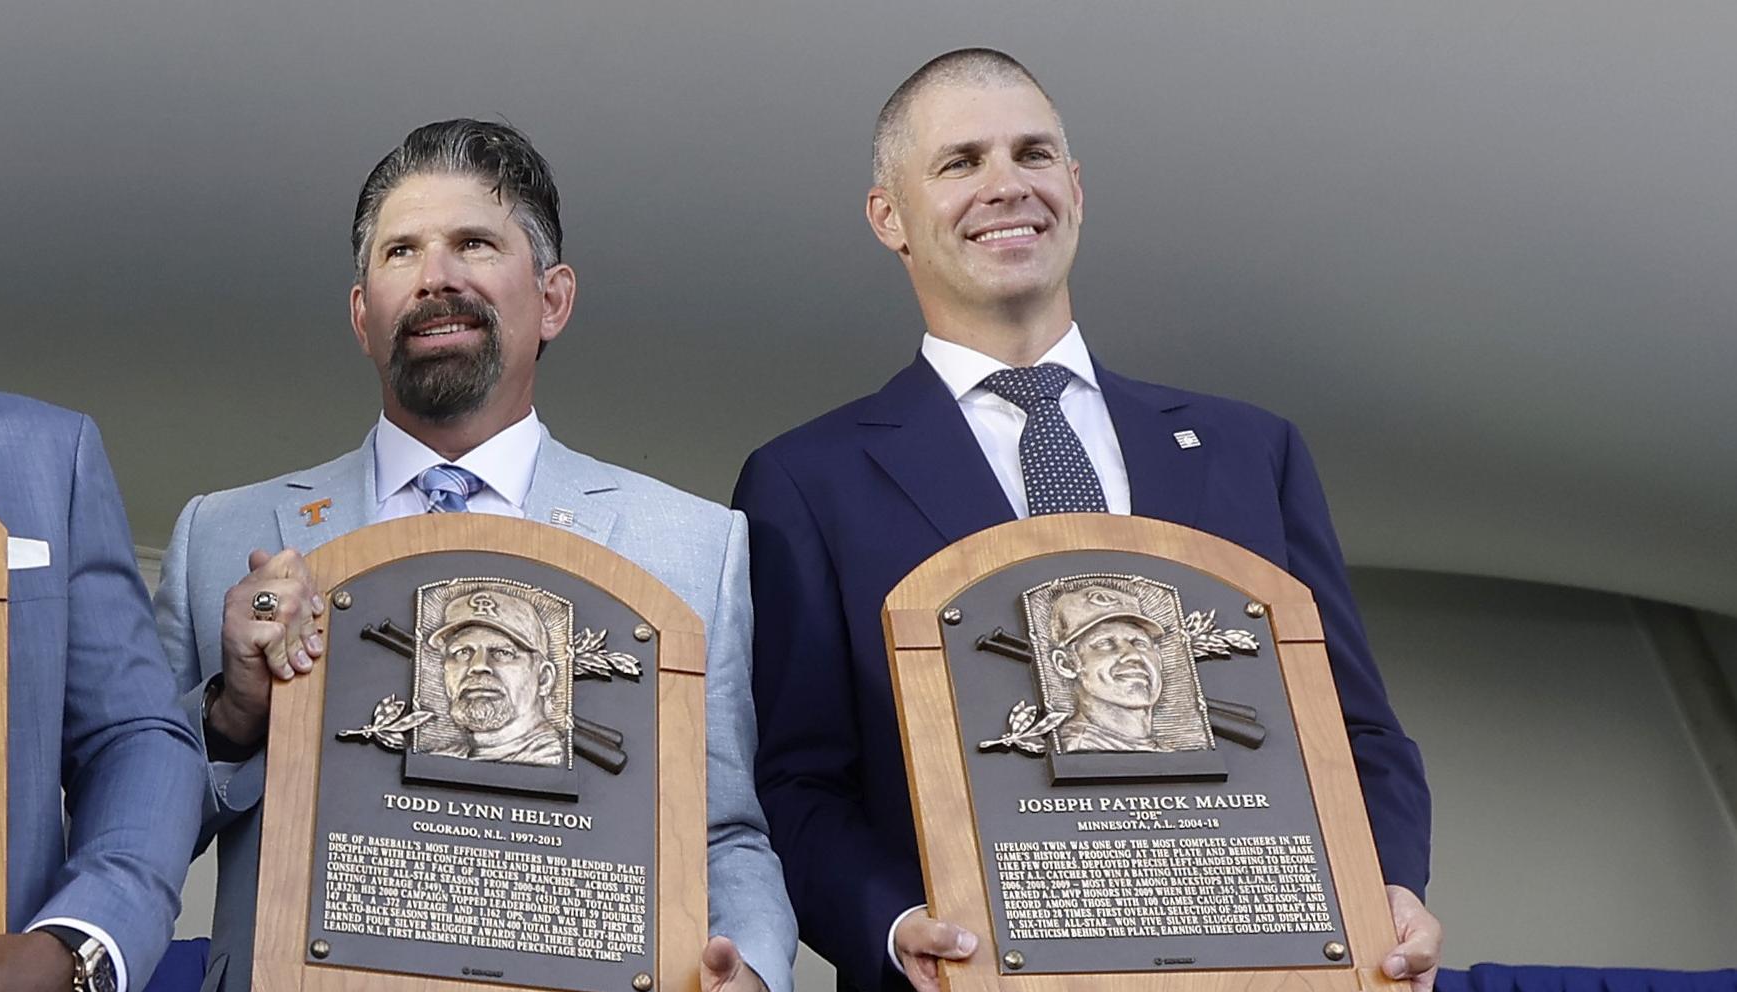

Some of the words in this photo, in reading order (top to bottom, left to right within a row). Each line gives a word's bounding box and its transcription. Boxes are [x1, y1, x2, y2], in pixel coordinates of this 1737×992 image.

[300, 498, 332, 527] T
[384, 794, 440, 811] TODD
[448, 801, 503, 819] LYNN
[511, 808, 591, 828] HELTON
[1019, 798, 1092, 811] JOSEPH
[1099, 796, 1189, 810] PATRICK
[1195, 794, 1269, 807] MAUER
[1077, 818, 1150, 830] MINNESOTA,
[1152, 818, 1175, 828] A.L.
[1177, 818, 1219, 827] 2004-18
[1129, 810, 1161, 819] "JOE"
[413, 821, 480, 837] COLORADO,
[484, 829, 506, 839] N.L.
[510, 832, 561, 845] 1997-2013
[1010, 928, 1069, 938] ATHLETICISM
[1070, 927, 1105, 937] BEHIND
[1106, 927, 1125, 936] THE
[1126, 926, 1159, 935] PLATE,
[1160, 925, 1202, 934] EARNING
[1202, 924, 1234, 933] THREE
[1235, 923, 1260, 932] GOLD
[1261, 922, 1293, 932] GLOVE
[1295, 921, 1335, 931] AWARDS.
[323, 920, 364, 932] LEADING
[366, 925, 384, 935] N.L.
[387, 927, 413, 938] FIRST
[415, 930, 456, 942] BASEMEN
[458, 934, 469, 943] IN
[471, 935, 514, 948] FIELDING
[517, 941, 575, 955] PERCENTAGE
[577, 947, 592, 957] SIX
[594, 949, 623, 960] TIMES.
